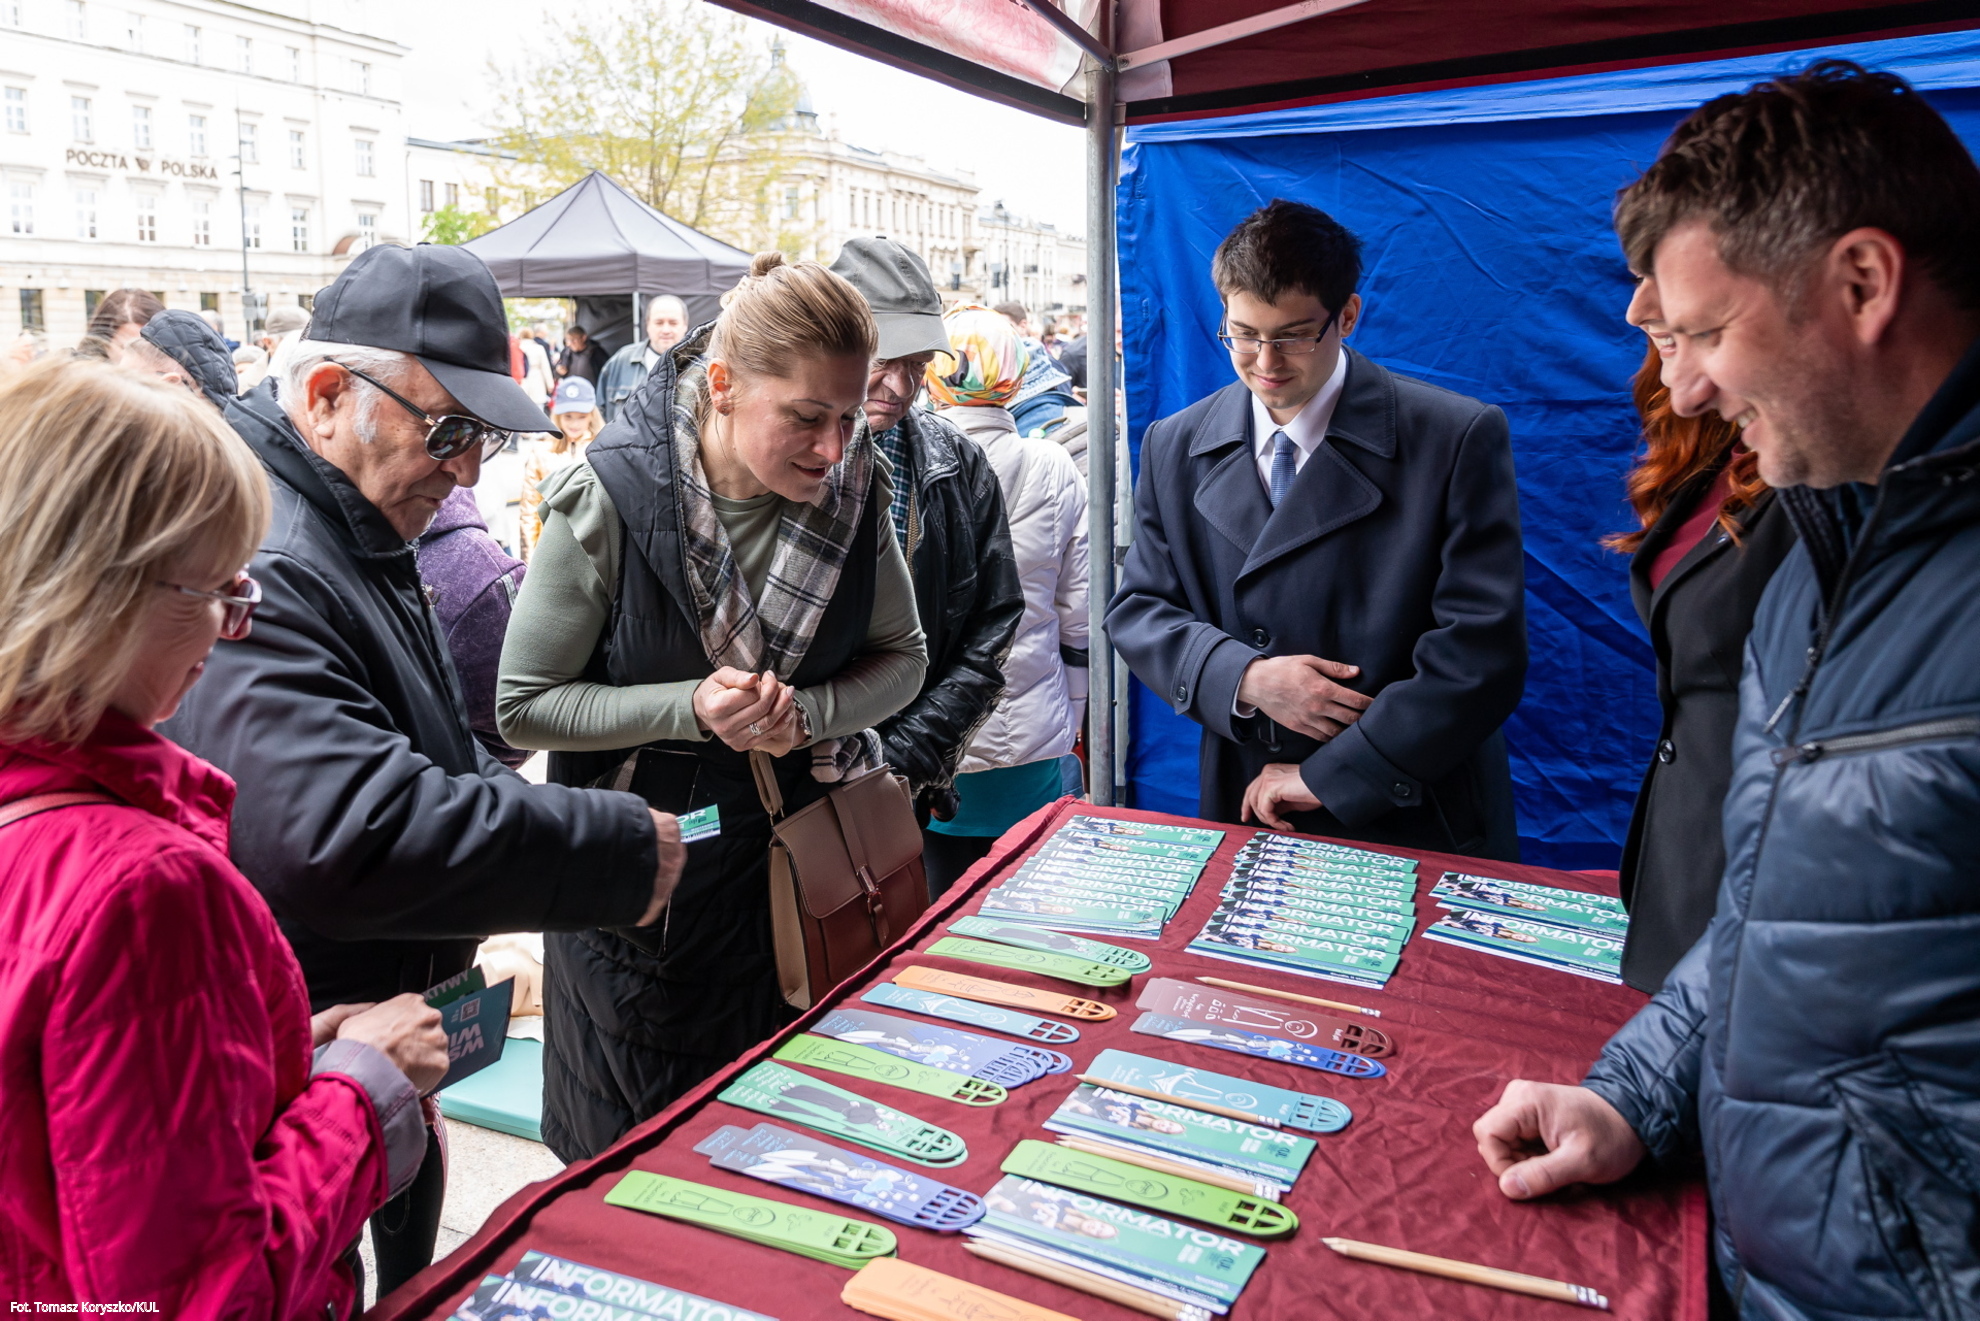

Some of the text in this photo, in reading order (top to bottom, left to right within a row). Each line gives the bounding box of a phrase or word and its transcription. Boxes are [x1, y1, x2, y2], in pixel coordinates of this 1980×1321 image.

[66, 149, 218, 180] POCZTA POLSKA
[1083, 816, 1216, 837] INFORMATOR
[1067, 831, 1203, 853] INFORMATOR
[1260, 842, 1405, 868] INFORMATOR
[1040, 859, 1182, 881] INFORMATOR
[1050, 850, 1192, 873] INFORMATOR
[1253, 861, 1404, 889] INFORMATOR
[1258, 851, 1406, 878] INFORMATOR
[1027, 871, 1174, 899] INFORMATOR
[1034, 864, 1179, 890] INFORMATOR
[1248, 869, 1401, 898] INFORMATOR
[1457, 874, 1619, 906] INFORMATOR
[1003, 890, 1156, 913] INFORMATOR
[1244, 890, 1404, 924] INFORMATOR
[1246, 880, 1404, 909] INFORMATOR
[1224, 913, 1395, 948] INFORMATOR
[1234, 899, 1396, 934] INFORMATOR
[1220, 923, 1388, 960] INFORMATOR
[1092, 1086, 1299, 1147] INFORMATOR
[1017, 1179, 1247, 1257] INFORMATOR
